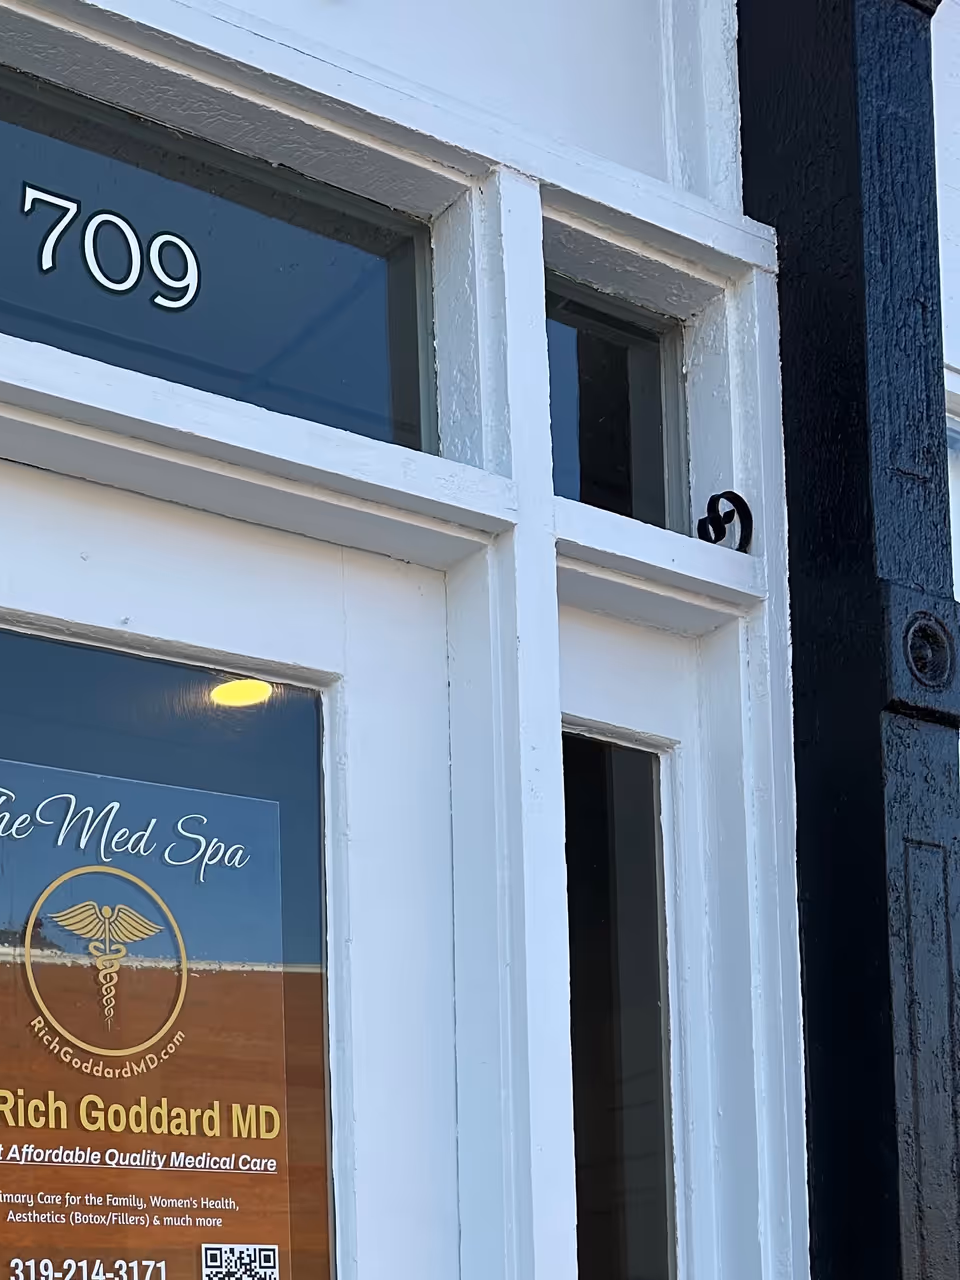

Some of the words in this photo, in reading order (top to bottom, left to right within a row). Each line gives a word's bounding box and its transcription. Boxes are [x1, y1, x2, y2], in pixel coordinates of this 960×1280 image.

[22, 184, 200, 310] 709
[35, 794, 157, 862] Med
[164, 814, 251, 883] Spa
[30, 1016, 186, 1079] RichGoddardMD.com
[79, 1094, 221, 1138] Goddard
[231, 1103, 281, 1140] MD
[5, 1144, 101, 1165] Affordable
[105, 1148, 167, 1170] Quality
[169, 1151, 235, 1171] Medical
[238, 1154, 277, 1172] Care
[6, 1209, 66, 1224] Aesthetics
[69, 1211, 150, 1228] (Botox/Fillers)
[152, 1215, 161, 1226] &
[163, 1214, 192, 1227] much
[195, 1216, 223, 1227] more
[37, 1191, 62, 1205] Care
[65, 1192, 81, 1208] for
[84, 1193, 103, 1206] the
[106, 1194, 147, 1210] Family,
[149, 1195, 198, 1209] Women's
[200, 1197, 240, 1211] Health,
